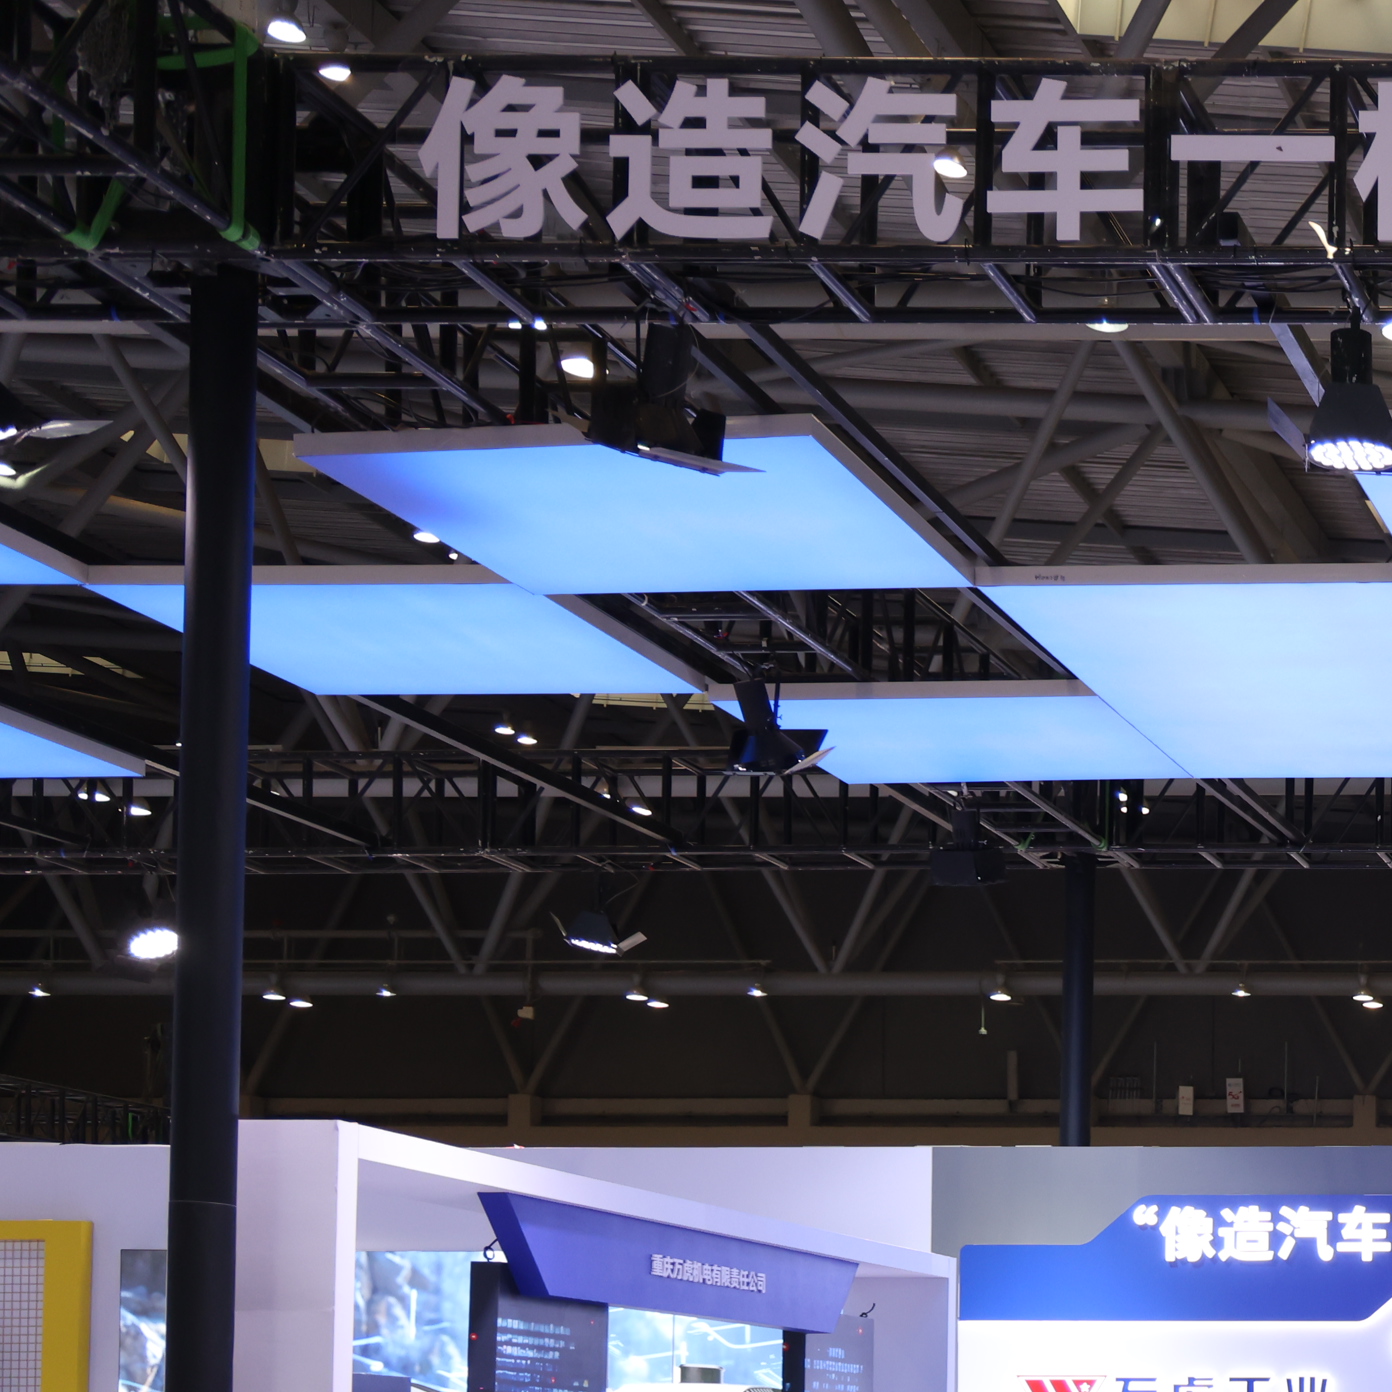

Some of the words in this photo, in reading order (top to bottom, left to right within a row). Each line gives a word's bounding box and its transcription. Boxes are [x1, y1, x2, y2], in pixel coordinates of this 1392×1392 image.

[651, 1254, 766, 1293] 重庆万虎机电有限责任公司
